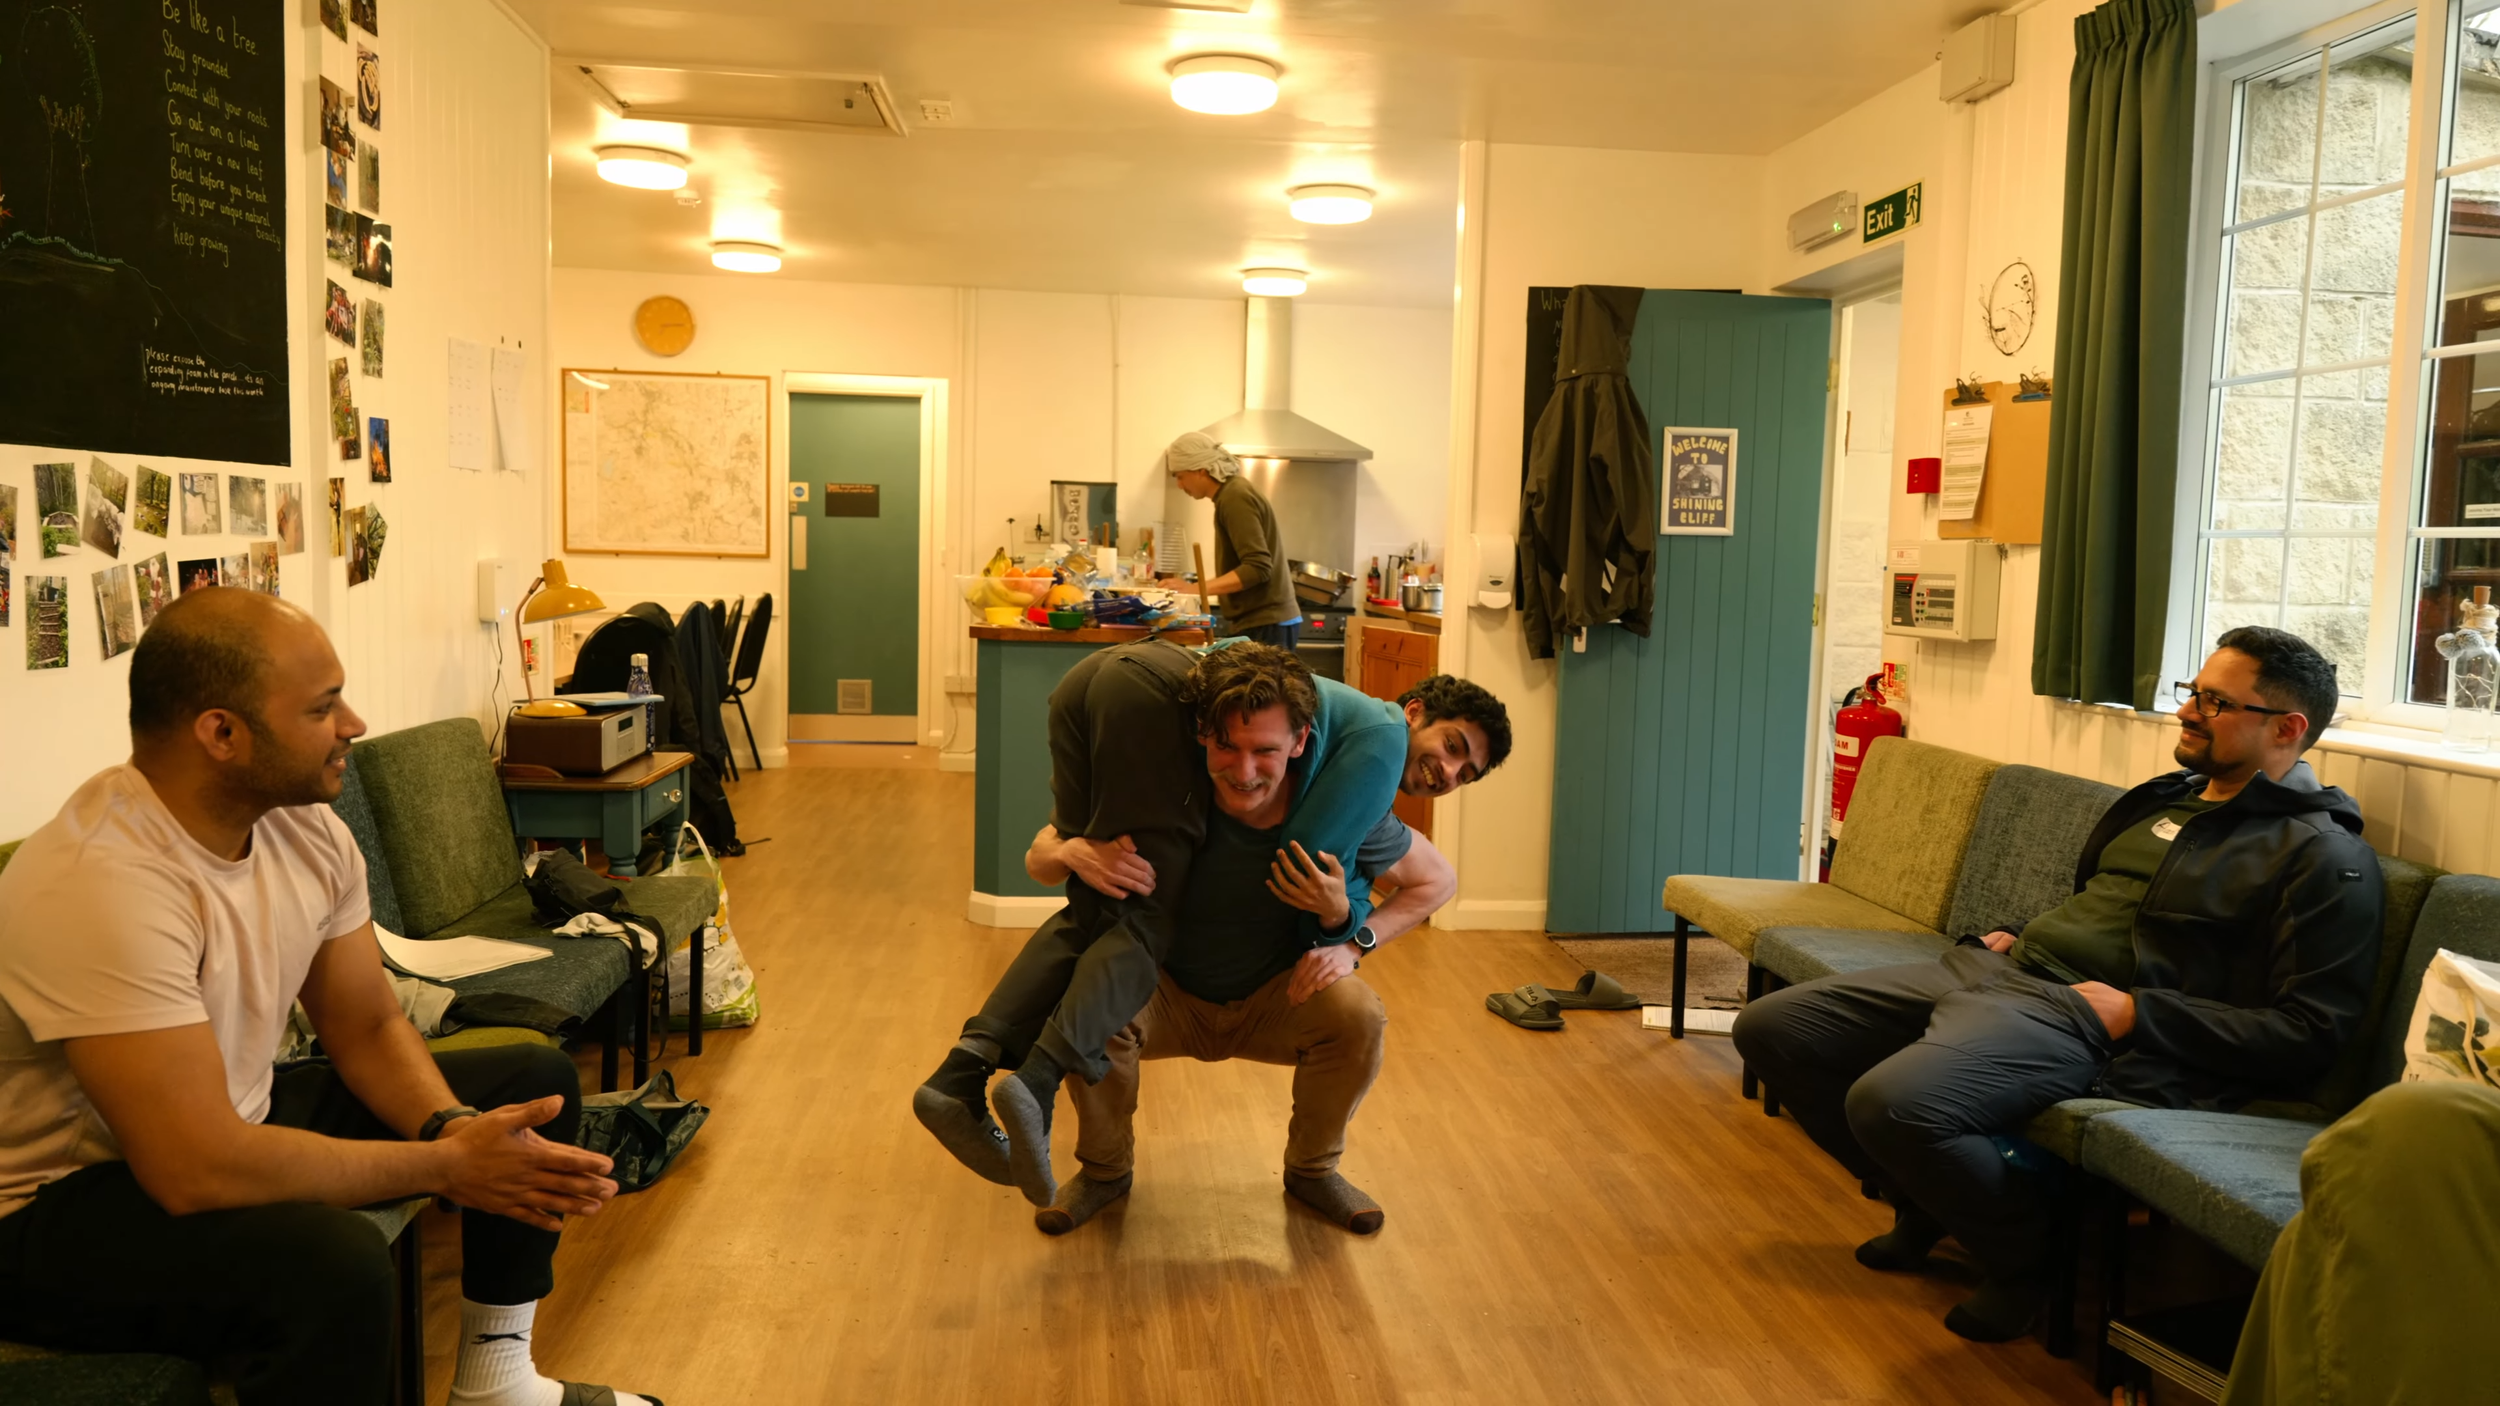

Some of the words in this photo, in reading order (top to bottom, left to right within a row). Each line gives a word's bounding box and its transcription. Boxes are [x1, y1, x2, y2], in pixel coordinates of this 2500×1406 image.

[163, 0, 180, 23] Be
[189, 0, 210, 33] like
[217, 26, 225, 42] a
[163, 29, 185, 72] Stay
[165, 69, 198, 99] Connect
[202, 87, 220, 108] with
[225, 101, 242, 120] your
[168, 99, 182, 125] Go
[189, 111, 204, 132] out
[210, 126, 222, 139] on
[227, 131, 235, 143] a
[169, 132, 191, 158] Turn
[194, 147, 212, 161] over
[217, 156, 223, 165] a
[227, 158, 240, 171] new
[171, 156, 194, 183] Bend
[200, 167, 225, 191] before
[230, 184, 242, 204] you
[171, 184, 195, 215] Enjoy
[198, 198, 216, 217] your
[220, 202, 243, 226] unique
[245, 207, 271, 227] natural
[1867, 203, 1894, 235] Exit
[173, 222, 195, 255] Keep
[256, 225, 281, 252] beauty
[196, 355, 206, 367] the
[1672, 436, 1728, 456] WELCOME
[1690, 453, 1708, 464] TO
[1672, 497, 1724, 511] SHINING
[1680, 512, 1716, 524] CLIFF
